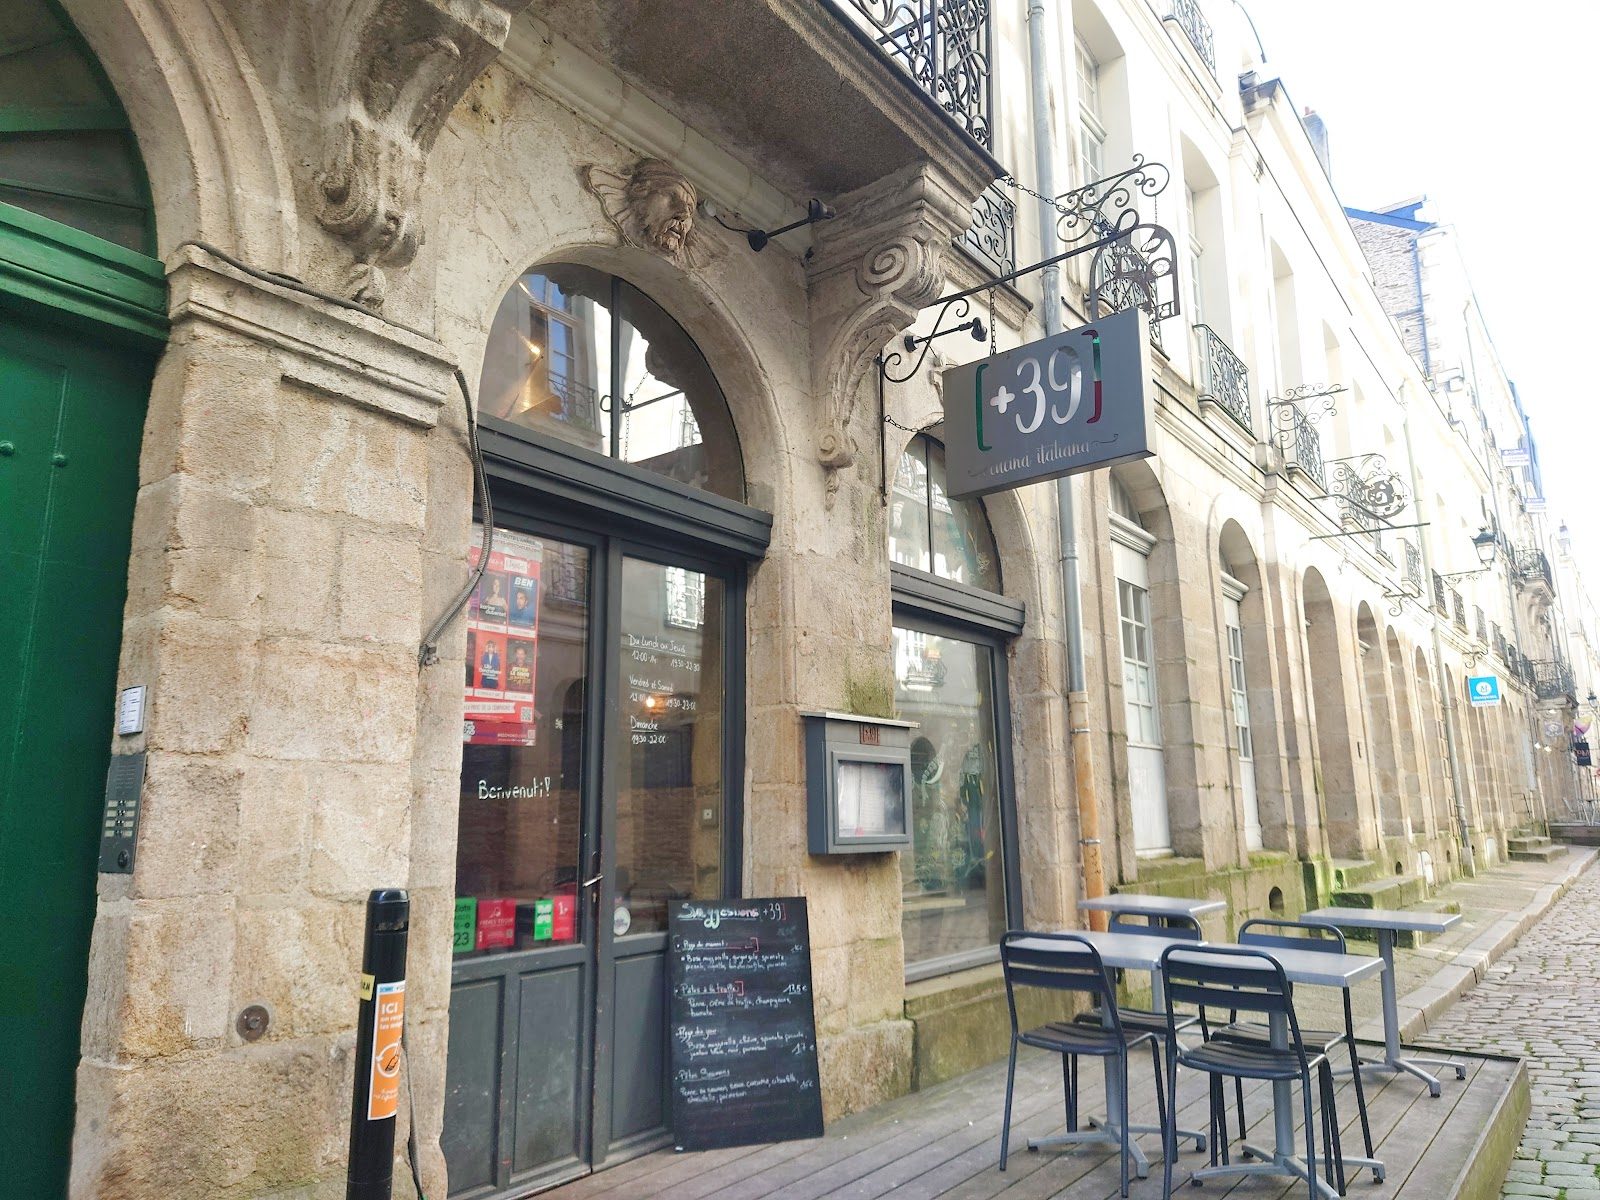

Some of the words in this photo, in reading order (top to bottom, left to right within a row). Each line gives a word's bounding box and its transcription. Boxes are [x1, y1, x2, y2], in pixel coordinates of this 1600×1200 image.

[1036, 439, 1089, 464] italiana
[514, 577, 534, 588] BEN
[630, 715, 659, 731] Dimanche
[478, 776, 551, 800] Benvenuti!
[381, 1002, 399, 1014] ICI
